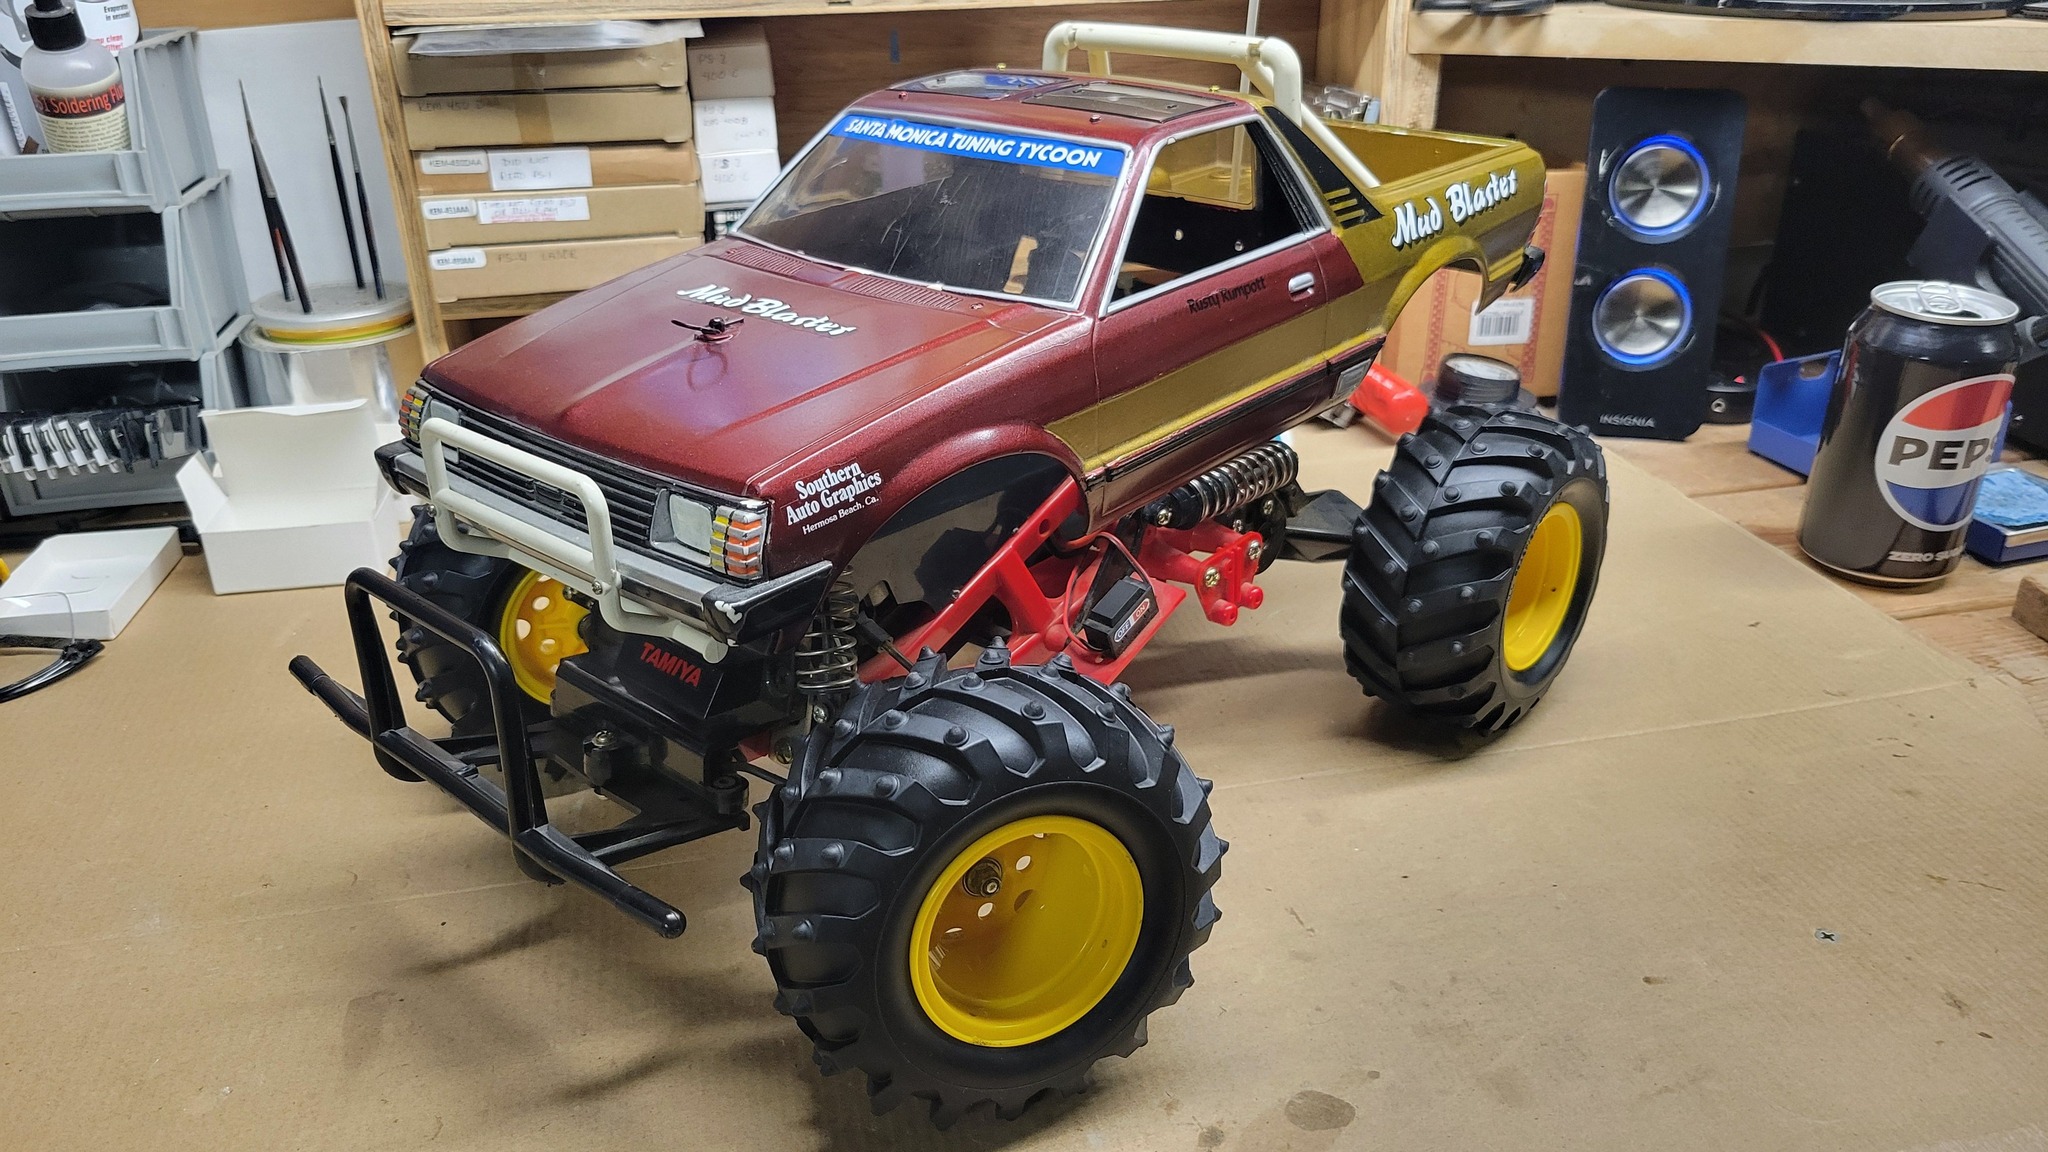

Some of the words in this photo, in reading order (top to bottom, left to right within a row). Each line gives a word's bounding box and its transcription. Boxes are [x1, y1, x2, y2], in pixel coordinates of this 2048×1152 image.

[50, 93, 112, 114] Soldering
[109, 83, 125, 103] Flu
[845, 118, 886, 138] SANTA
[885, 124, 945, 148] MONICA
[948, 132, 1016, 156] TUNING
[1016, 142, 1103, 168] TYCOON
[1391, 195, 1444, 250] Mud
[1445, 168, 1519, 225] Blaster
[676, 283, 752, 308] Mud
[741, 297, 857, 336] Blaster
[1187, 292, 1221, 314] Rusty
[1220, 275, 1267, 302] Rumpott
[1599, 413, 1656, 428] INSIGNIA
[786, 500, 821, 526] Auto
[820, 472, 882, 508] Graphics
[794, 462, 862, 500] Southern
[802, 514, 838, 535] Hermosa
[838, 501, 865, 518] Beach,
[864, 495, 880, 506] Ca.
[1887, 550, 1934, 562] ZERO
[1117, 620, 1131, 639] OFF
[1136, 603, 1146, 618] ON
[640, 641, 702, 688] TAMIYA
